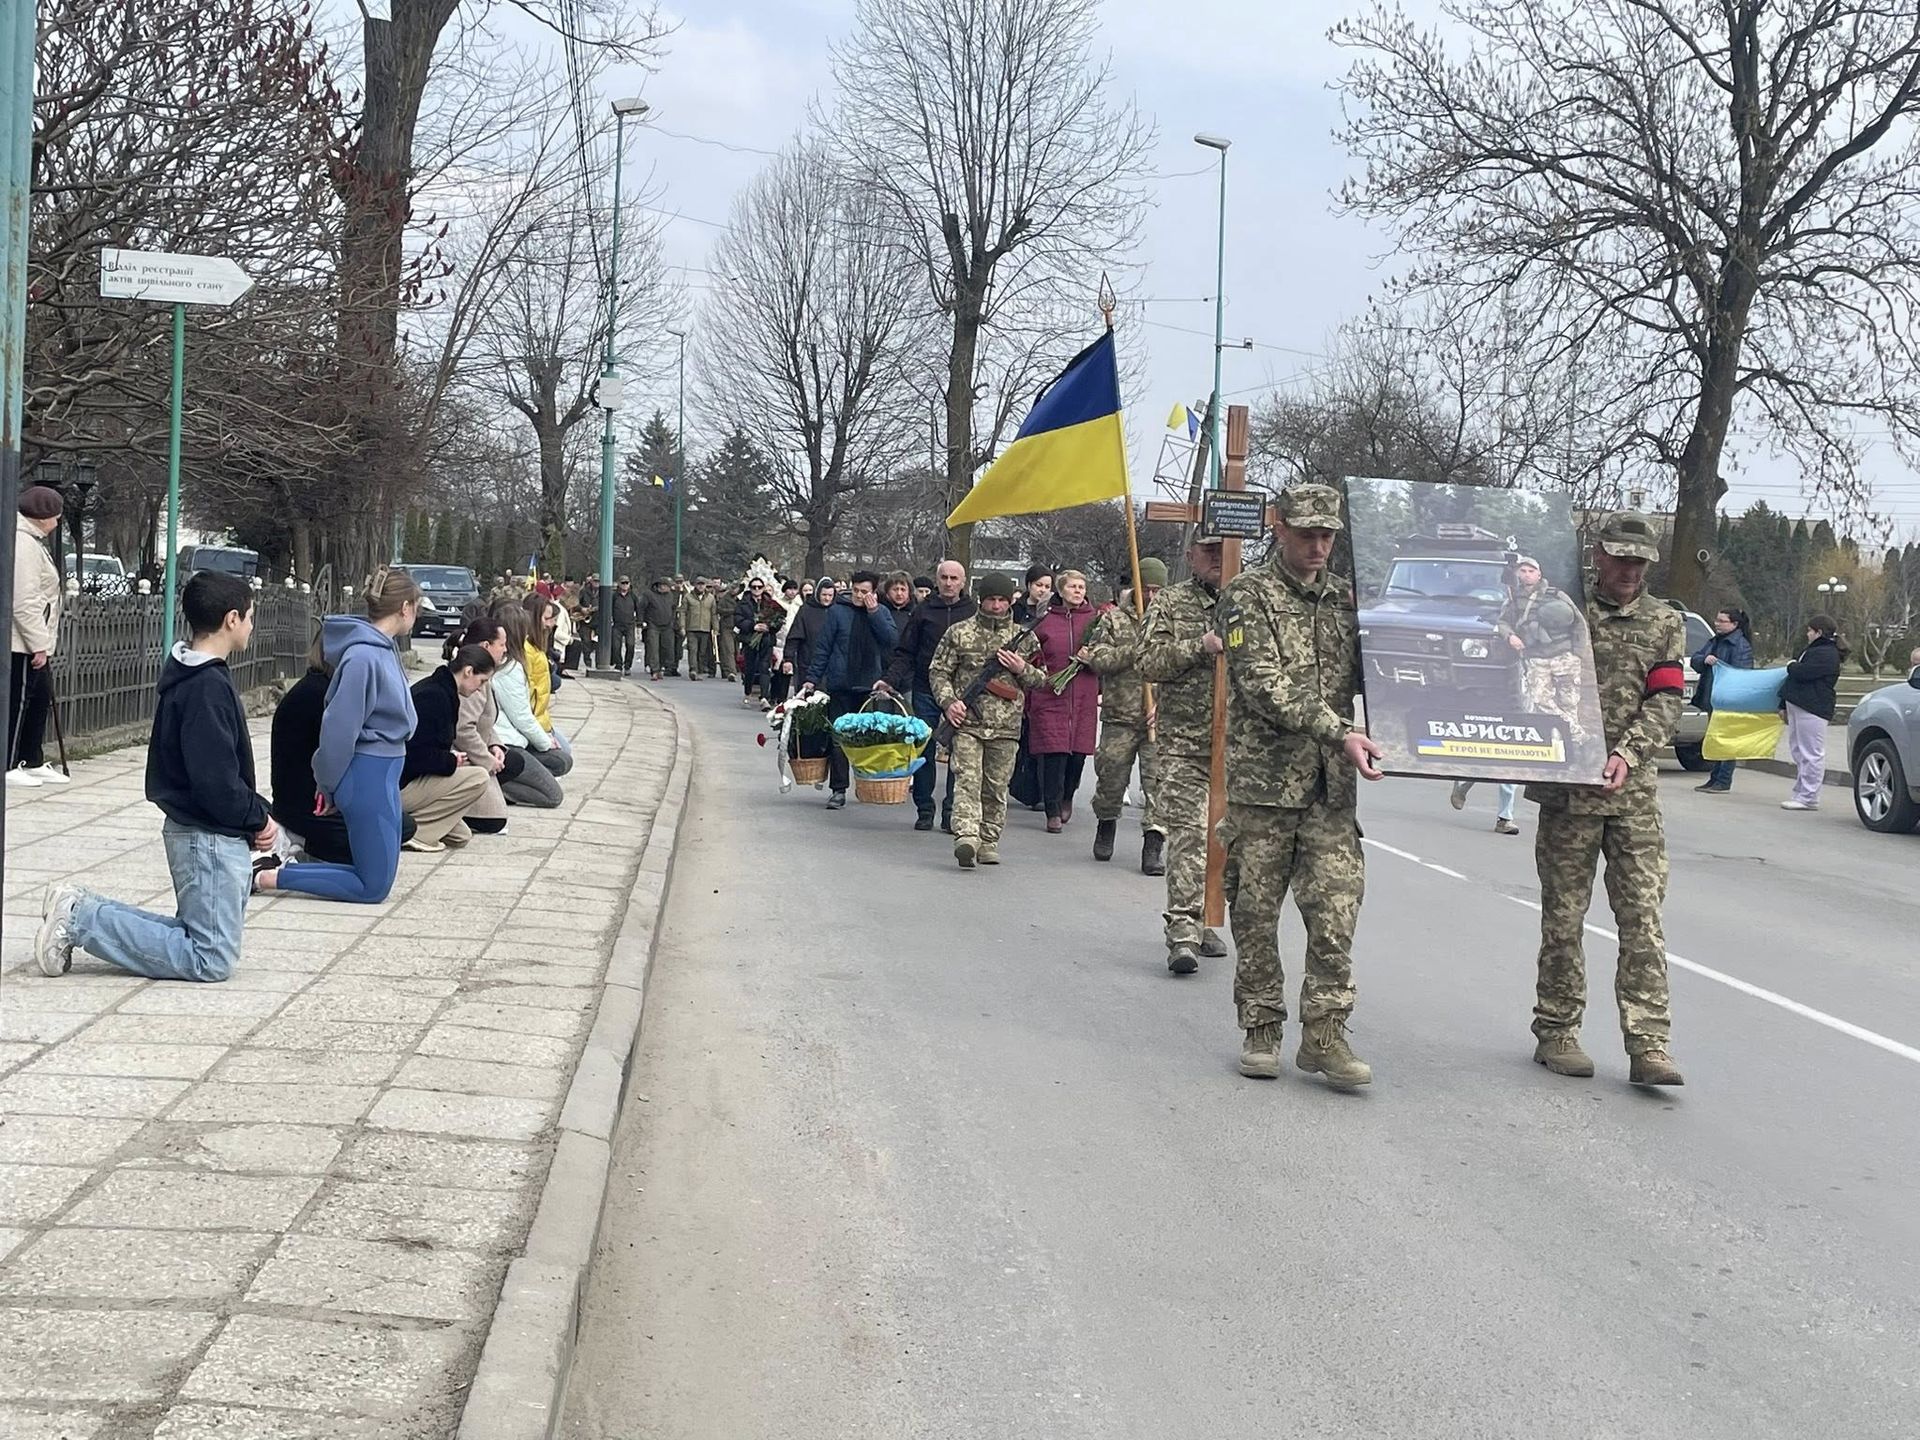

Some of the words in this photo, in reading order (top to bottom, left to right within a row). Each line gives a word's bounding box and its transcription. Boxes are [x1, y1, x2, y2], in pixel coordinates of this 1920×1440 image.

[108, 261, 137, 271] Вдділ
[142, 264, 194, 277] реєстрації
[108, 276, 133, 284] актів
[137, 278, 192, 288] цивільного
[197, 283, 224, 292] стану
[1427, 721, 1543, 742] БАРИСТА
[1479, 747, 1491, 755] НЕ
